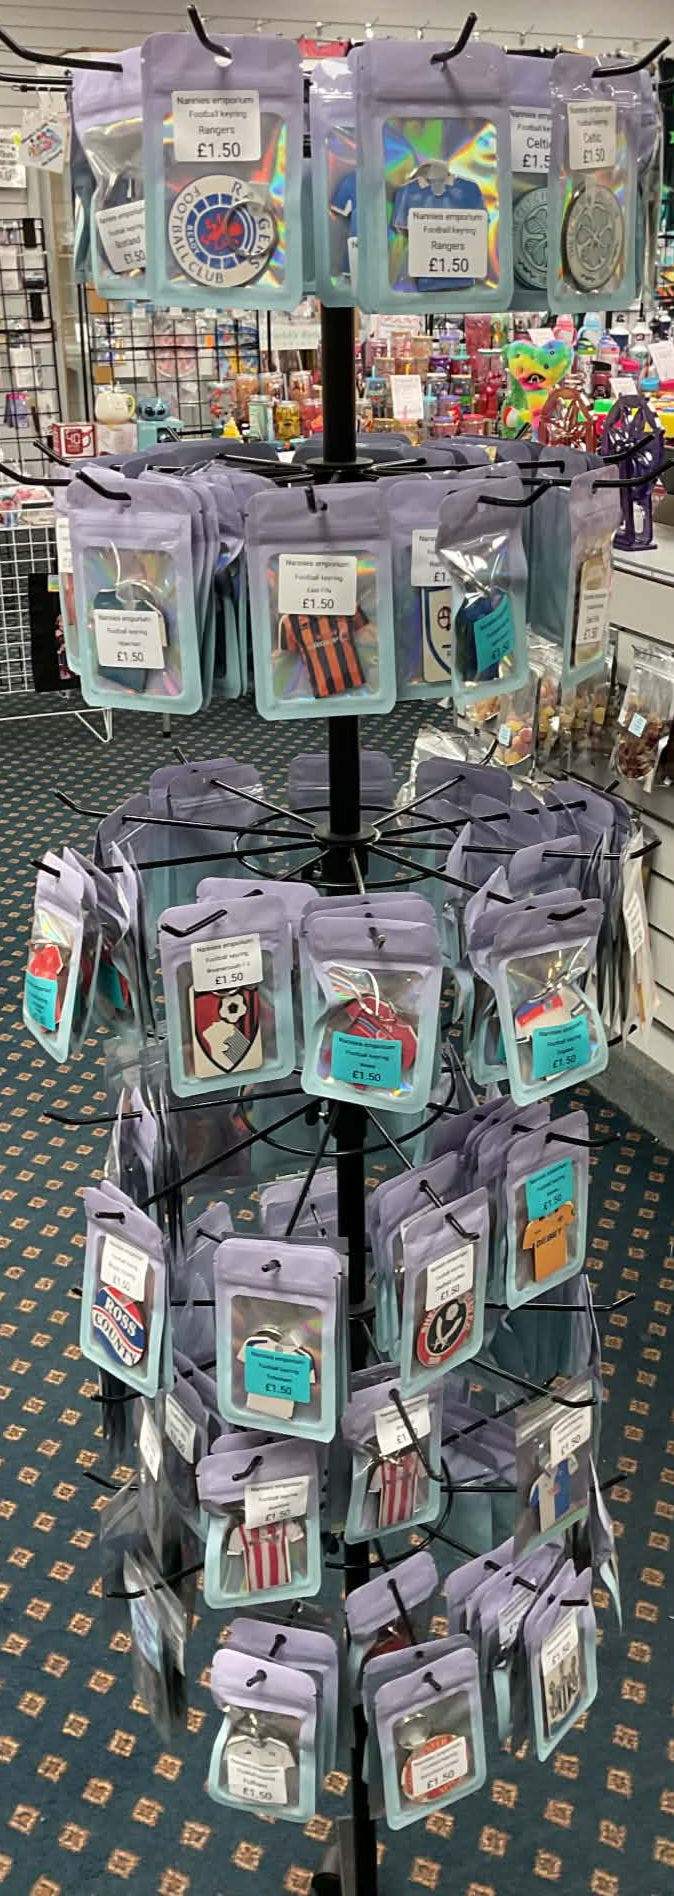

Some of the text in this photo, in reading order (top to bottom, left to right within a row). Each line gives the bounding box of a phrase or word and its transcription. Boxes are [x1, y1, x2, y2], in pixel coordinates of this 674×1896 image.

[177, 96, 254, 106] Nannies emporium
[189, 110, 247, 119] Football keyring
[198, 126, 236, 136] Rangers
[197, 142, 241, 158] £1.50
[583, 148, 605, 163] £1.50
[523, 154, 551, 168] £1.5
[172, 185, 202, 265] FOOTBALL
[452, 227, 476, 236] keyring
[431, 241, 465, 252] Rangers
[428, 257, 469, 272] £1.50
[188, 261, 224, 284] CLUB
[302, 598, 335, 609] £1.50
[117, 651, 144, 662] £1.50
[215, 972, 244, 985] £1.50
[552, 1054, 577, 1069] £1.50
[352, 1070, 381, 1082] £1.50
[104, 1297, 137, 1337] ROSS
[94, 1312, 141, 1364] COUNTY
[265, 1383, 292, 1395] £1.50
